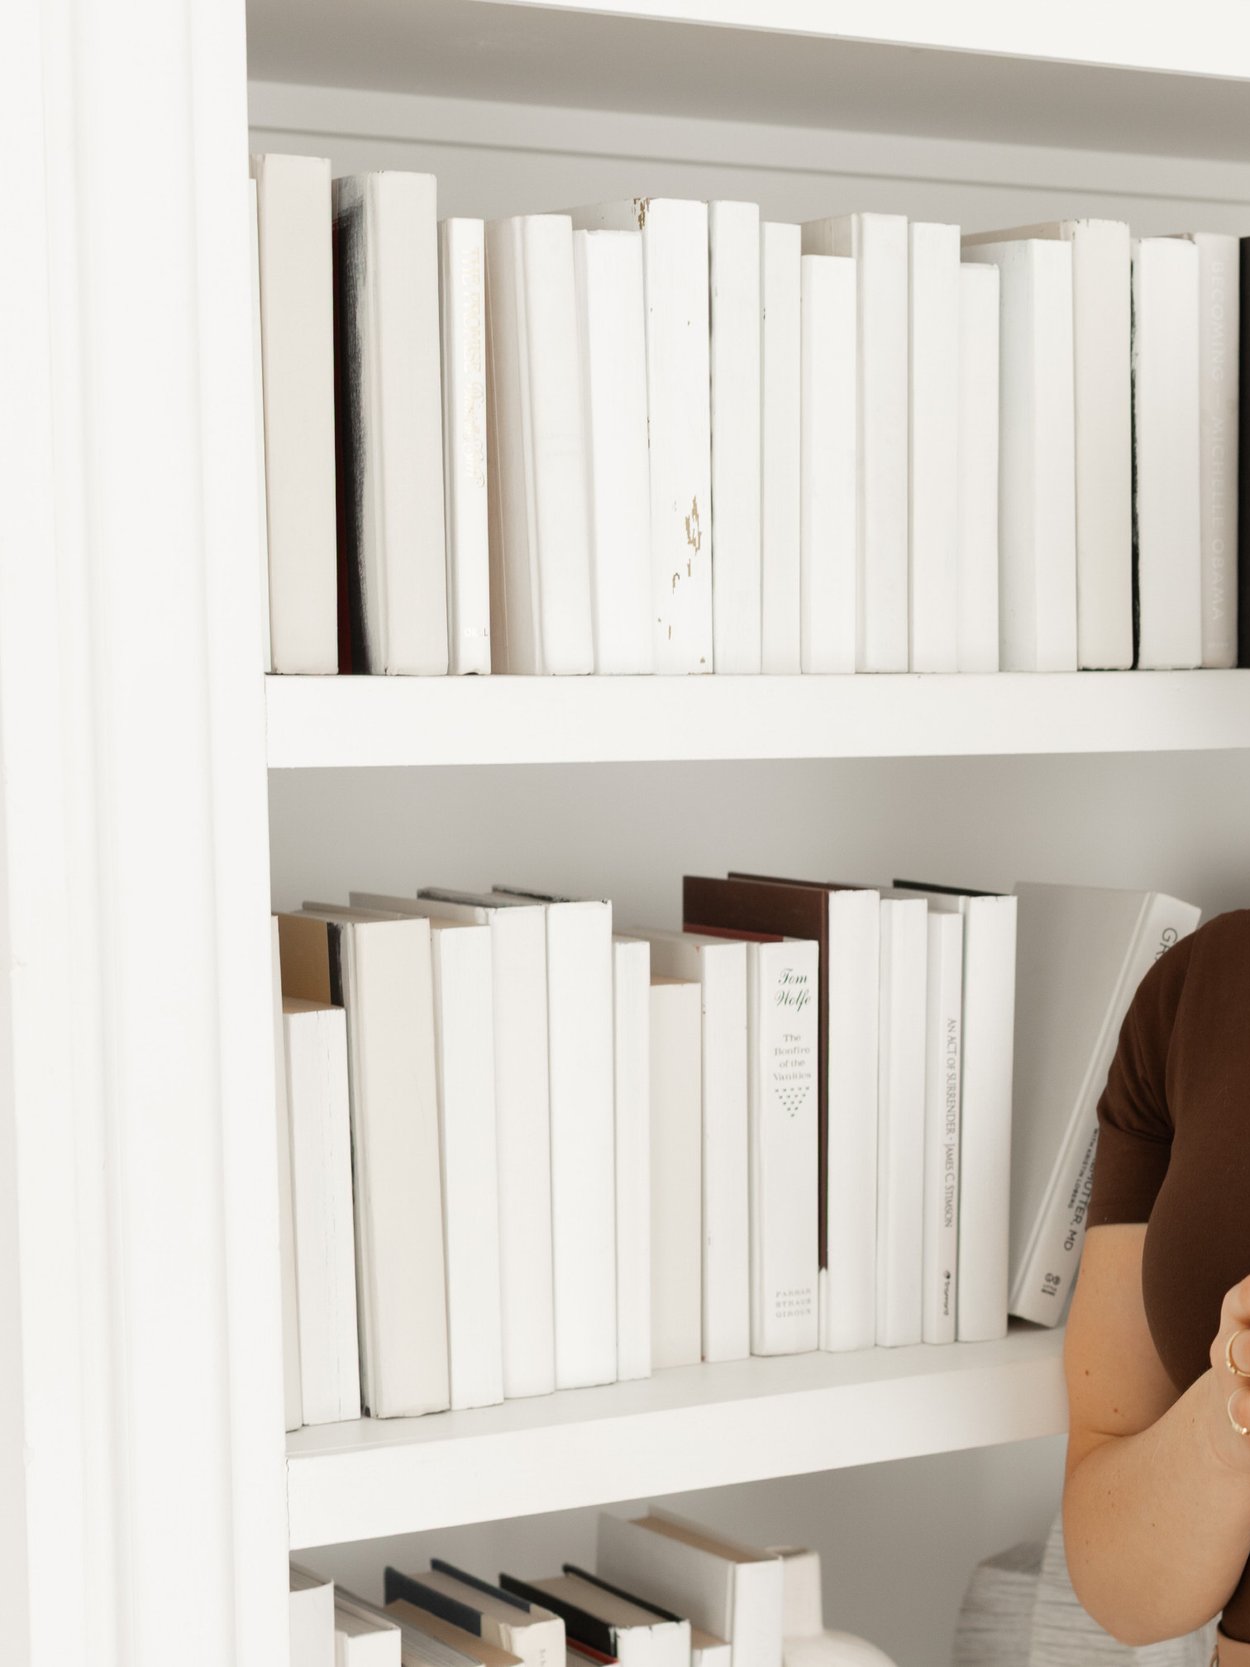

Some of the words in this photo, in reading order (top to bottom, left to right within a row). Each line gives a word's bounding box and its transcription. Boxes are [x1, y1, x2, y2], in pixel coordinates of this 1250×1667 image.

[1211, 260, 1226, 384] BECOMING
[1210, 415, 1225, 528] MICHELLE
[1210, 537, 1225, 622] OBAMA
[1154, 928, 1179, 961] GR
[777, 967, 808, 985] Tom
[774, 987, 812, 1013] Wolfe
[783, 1033, 802, 1042] The
[946, 1018, 957, 1033] AN
[774, 1046, 811, 1056] Bonfire
[946, 1035, 957, 1056] ACT
[779, 1059, 789, 1068] of
[790, 1059, 806, 1067] the
[945, 1057, 957, 1070] OF
[773, 1071, 812, 1081] Vanities
[944, 1072, 957, 1135] SURRENDER
[943, 1143, 956, 1171] JAMES
[1070, 1157, 1096, 1226] MUTTER,
[944, 1185, 954, 1228] STIMSON
[1063, 1229, 1078, 1251] MD
